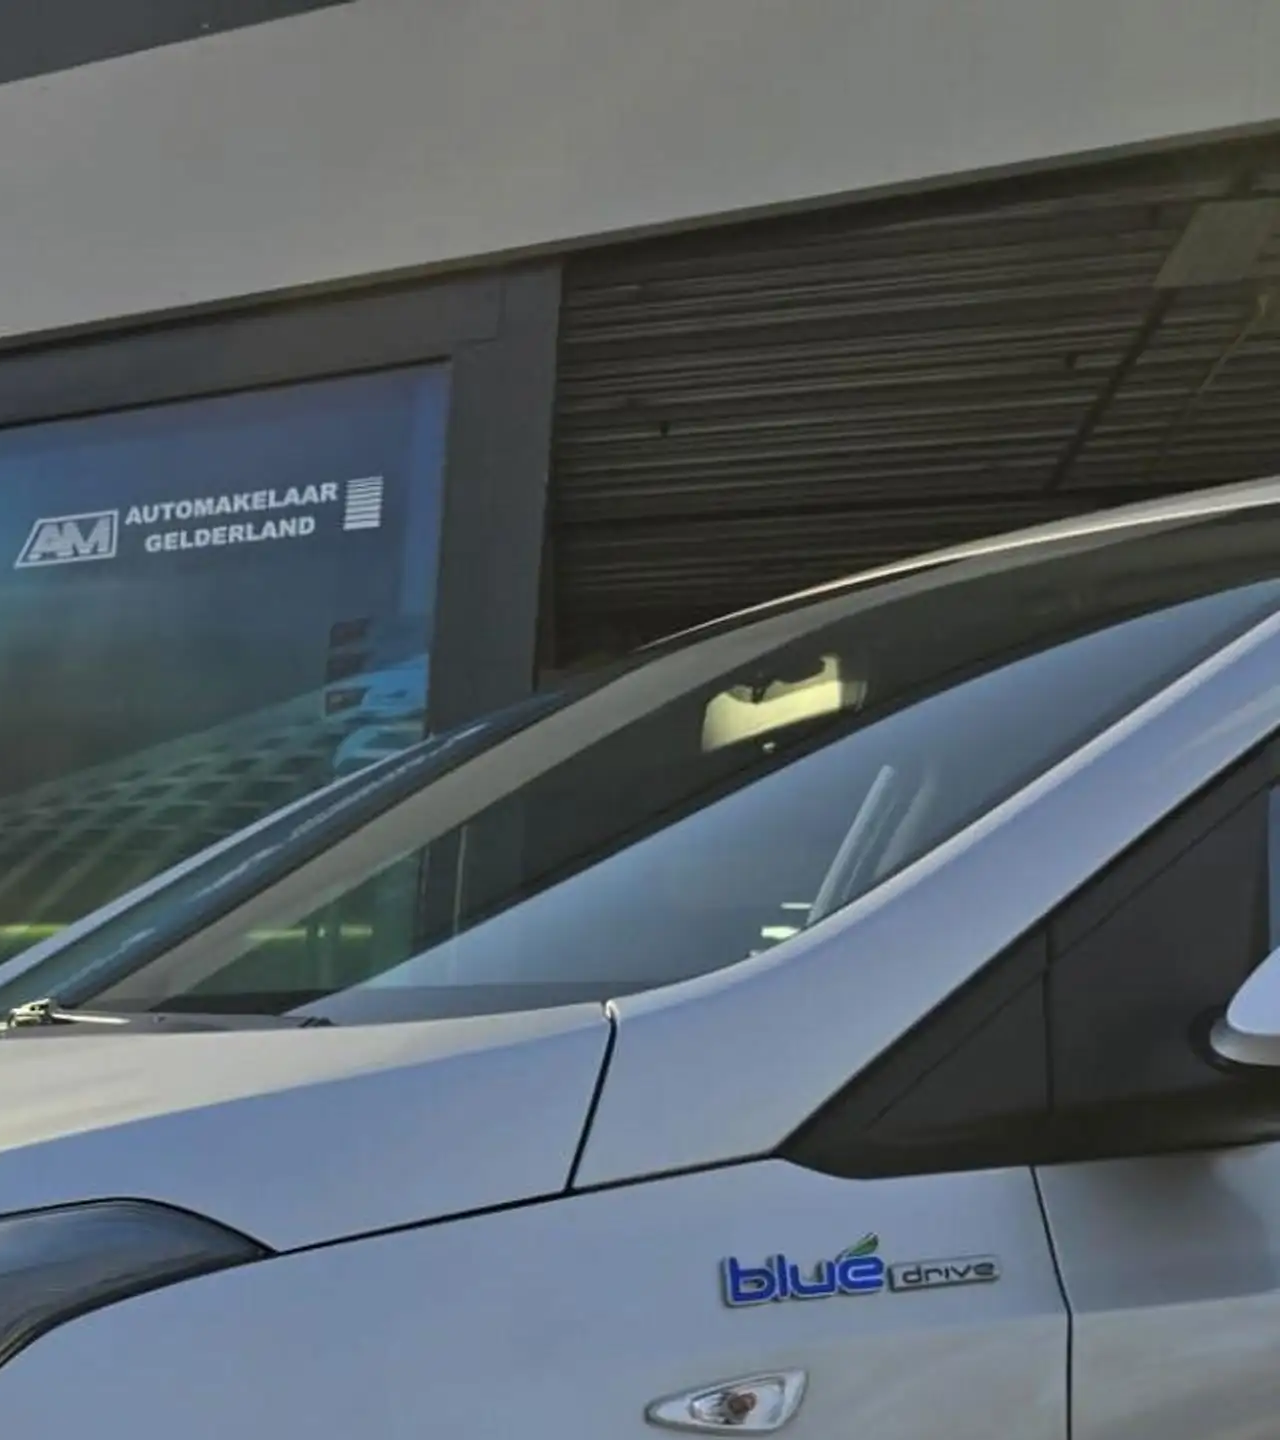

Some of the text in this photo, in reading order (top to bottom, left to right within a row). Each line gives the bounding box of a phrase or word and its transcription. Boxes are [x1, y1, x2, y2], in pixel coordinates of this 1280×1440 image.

[125, 482, 338, 526] AUTOMAKELAAR
[144, 516, 315, 552] GELDERLAND
[724, 1254, 997, 1306] blue drive
